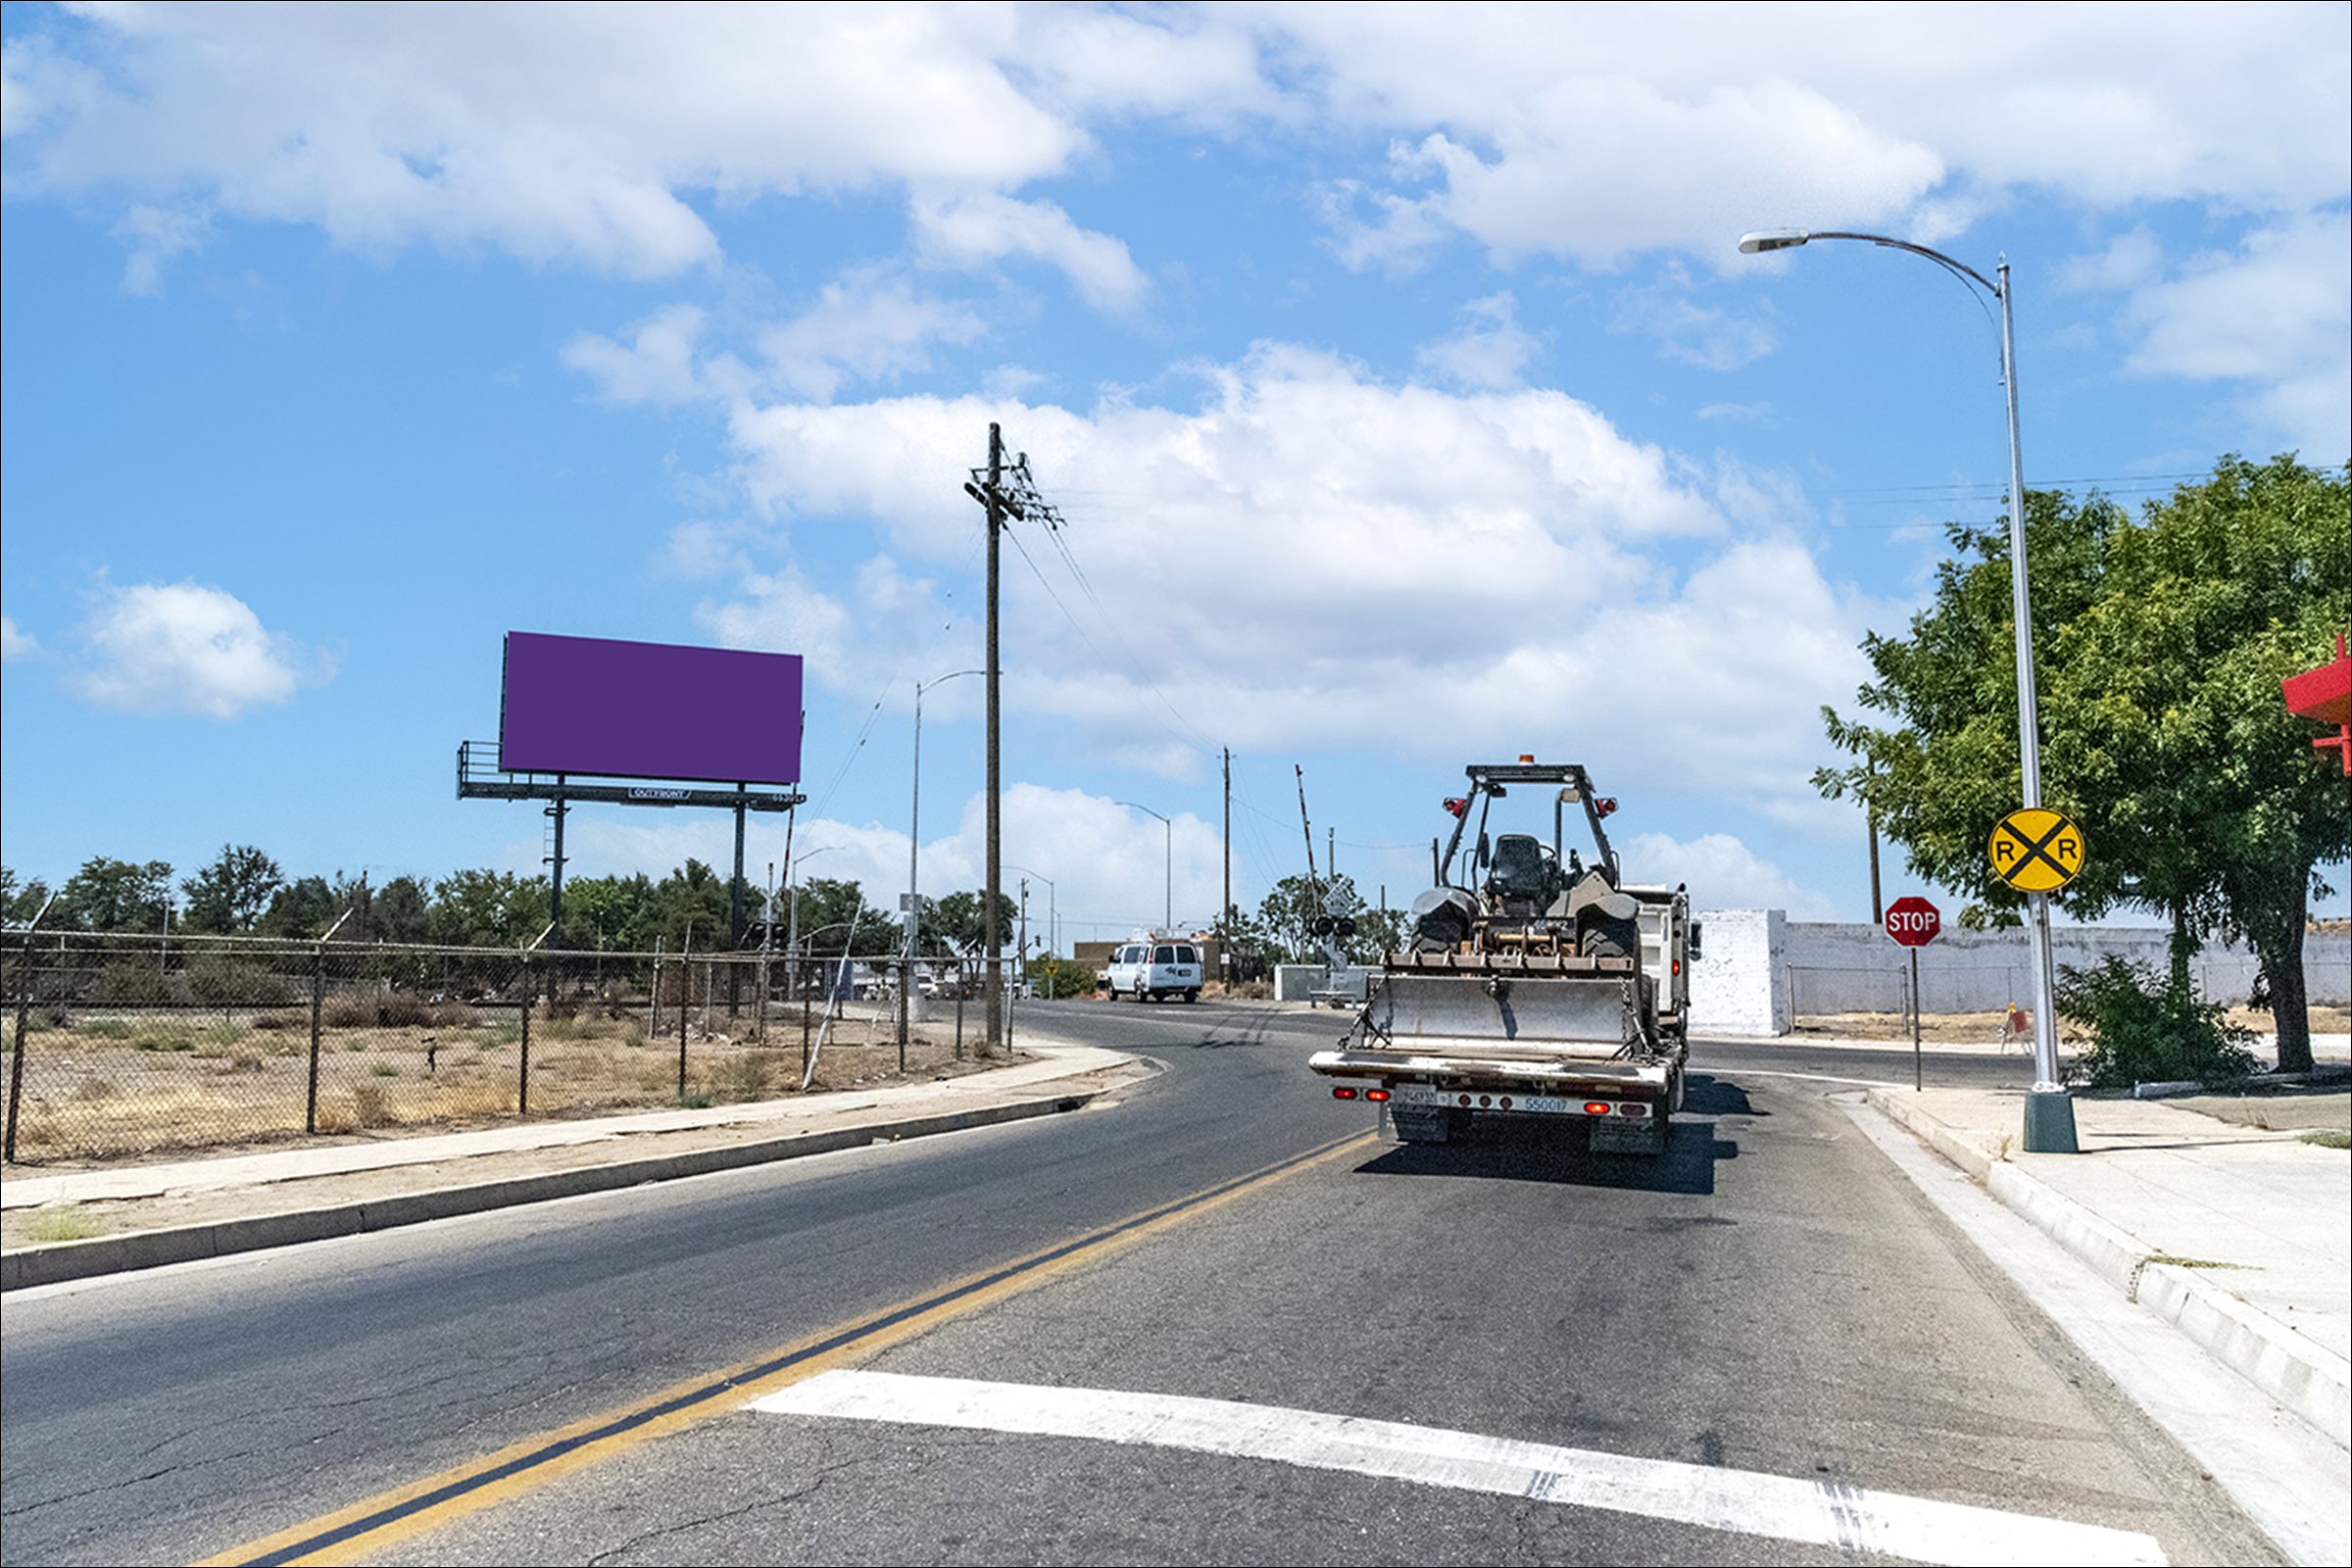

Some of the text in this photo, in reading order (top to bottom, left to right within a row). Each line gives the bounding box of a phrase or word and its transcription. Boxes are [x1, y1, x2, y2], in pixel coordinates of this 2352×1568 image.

[1996, 838, 2077, 861] R R
[1888, 911, 1936, 932] STOP
[1525, 1097, 1568, 1111] 550017
